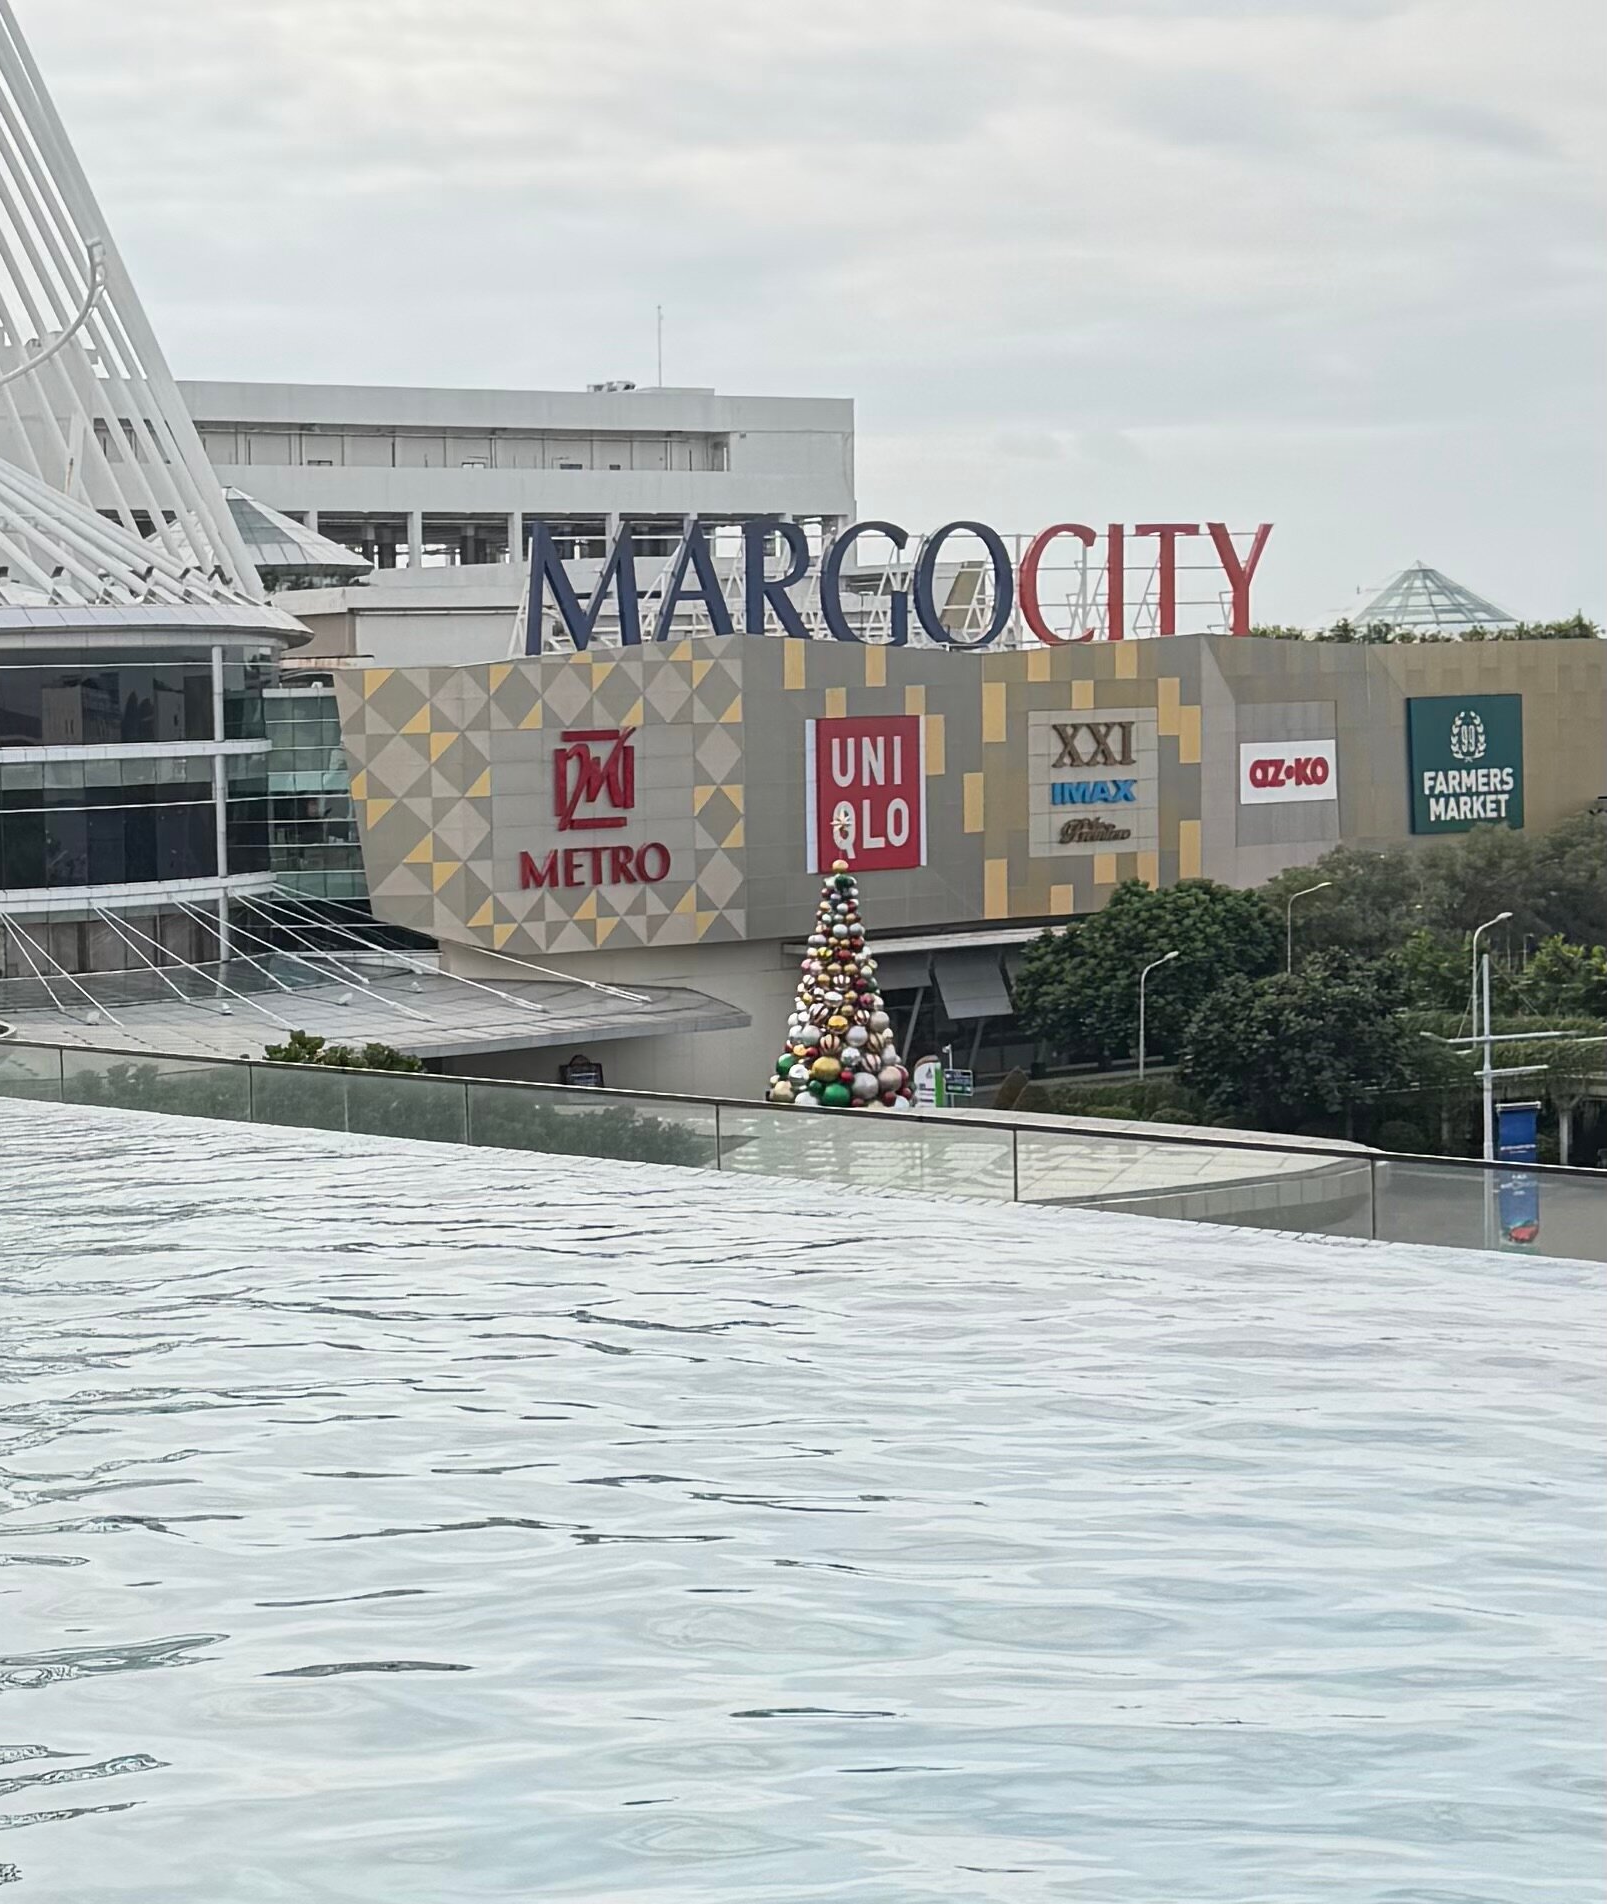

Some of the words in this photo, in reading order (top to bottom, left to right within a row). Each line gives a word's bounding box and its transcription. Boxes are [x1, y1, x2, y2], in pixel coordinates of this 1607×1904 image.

[831, 735, 902, 788] UNI
[1051, 721, 1137, 768] XXI
[1050, 779, 1138, 806] IMAX
[1423, 767, 1515, 795] FARMERS
[831, 797, 910, 860] QLO
[1429, 794, 1510, 822] MARKET
[519, 842, 671, 890] METRO
